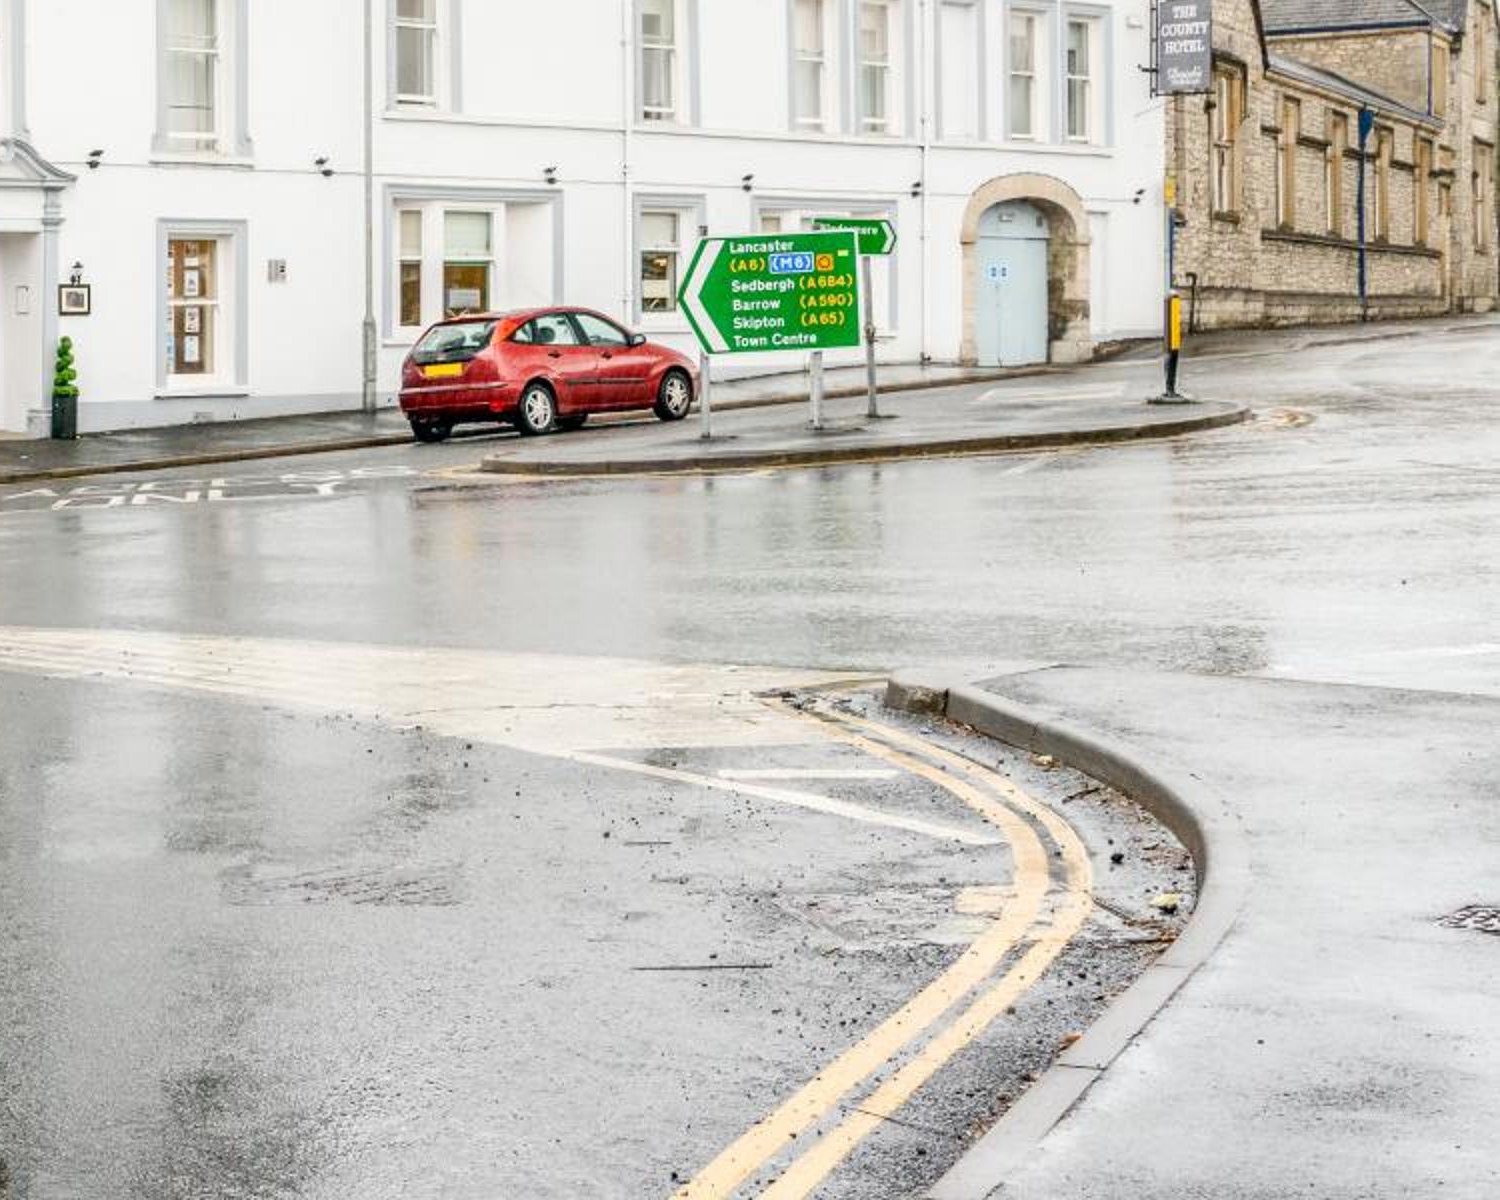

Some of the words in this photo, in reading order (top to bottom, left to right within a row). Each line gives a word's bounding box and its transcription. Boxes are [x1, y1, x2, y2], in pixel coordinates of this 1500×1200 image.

[1172, 5, 1197, 19] THE
[1161, 21, 1210, 37] COUNTY
[1164, 39, 1205, 54] HOTEL
[729, 240, 794, 254] Lancaster
[729, 258, 766, 273] (A6)
[773, 256, 811, 271] (M6)
[731, 278, 795, 293] Sedbergh
[799, 273, 853, 290] (A684)
[733, 299, 781, 311] Barrow
[799, 293, 853, 309] (A590)
[733, 315, 785, 329] Skipton
[801, 311, 845, 327] (A65)
[734, 335, 767, 347] Town
[772, 333, 817, 345] Centre
[51, 480, 348, 510] ONLY
